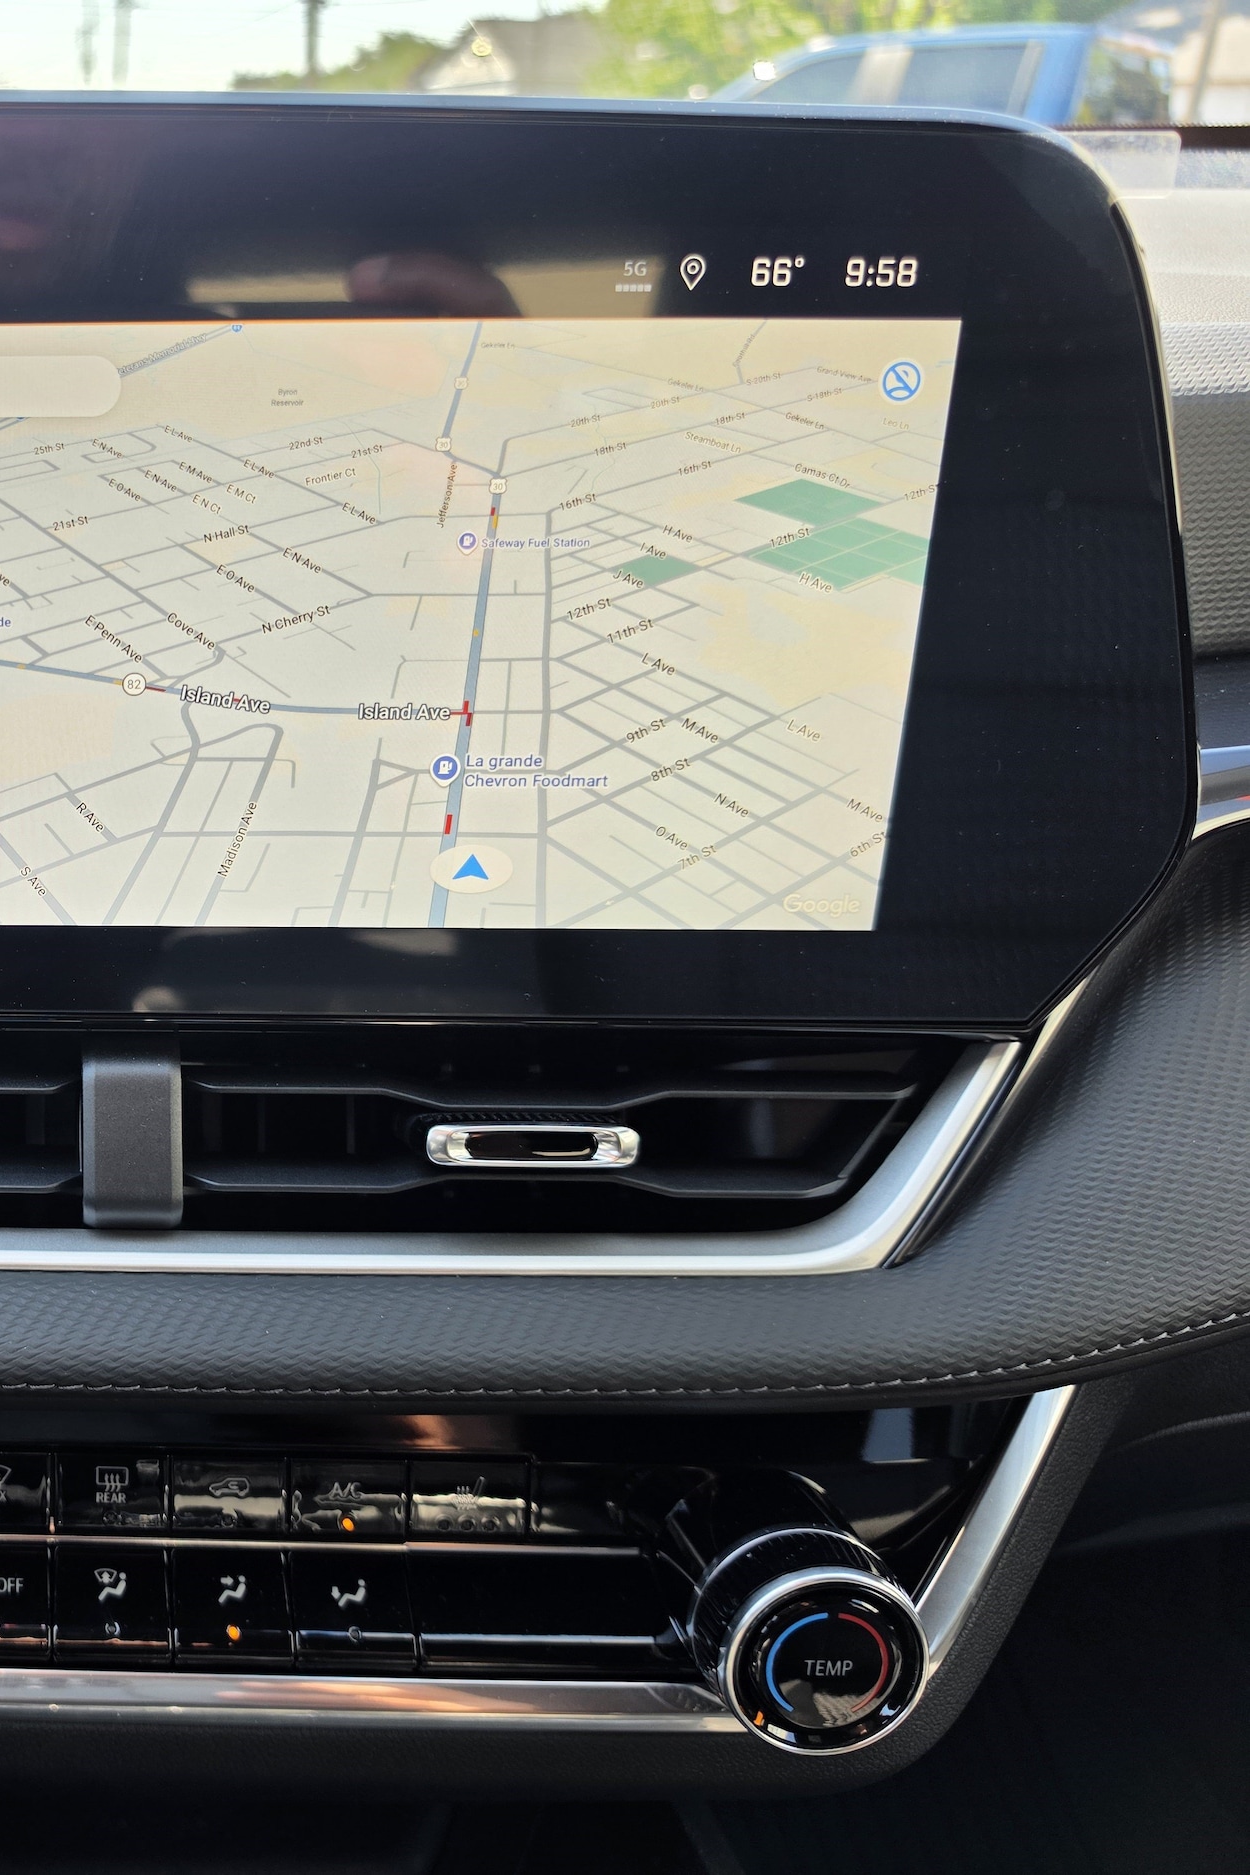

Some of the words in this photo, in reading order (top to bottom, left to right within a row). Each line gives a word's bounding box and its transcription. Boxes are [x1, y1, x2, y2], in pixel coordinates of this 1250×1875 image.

[623, 260, 648, 276] 5G
[751, 256, 804, 287] 66°
[845, 256, 918, 287] 9:58
[117, 357, 150, 376] eterans
[278, 388, 297, 397] Byron
[570, 418, 589, 428] 20th
[590, 415, 600, 423] St
[785, 411, 813, 426] Gekeler
[34, 446, 53, 455] 25th
[54, 443, 65, 451] St
[289, 440, 310, 450] 22nd
[312, 437, 323, 445] St
[351, 448, 371, 458] 21st
[372, 445, 383, 453] St
[594, 446, 614, 456] 18th
[616, 442, 626, 451] St
[685, 432, 730, 451] Steamboat
[731, 444, 741, 453] Ln
[244, 459, 250, 468] E
[258, 466, 275, 478] Ave
[306, 471, 342, 486] Frontier
[345, 468, 356, 477] Ct
[678, 463, 699, 476] 16th
[700, 460, 712, 470] St
[795, 464, 826, 478] Camas
[840, 478, 850, 488] Dr
[227, 485, 234, 493] E
[235, 488, 245, 498] M
[245, 493, 256, 503] Ct
[437, 482, 453, 528] Jefferson
[447, 464, 458, 481] Ave
[558, 498, 583, 510] 16th
[585, 493, 597, 503] St
[904, 488, 926, 501] 12th
[928, 483, 939, 494] S
[342, 503, 349, 512] E
[357, 510, 376, 524] Ave
[53, 519, 75, 531] 21st
[77, 516, 88, 525] St
[204, 534, 212, 543] N
[214, 527, 235, 541] Hall
[237, 525, 249, 534] St
[663, 524, 673, 536] H
[675, 529, 693, 543] Ave
[769, 532, 795, 548] 12th
[797, 527, 810, 539] St
[481, 538, 525, 550] Safeway
[528, 538, 549, 547] Fuel
[554, 538, 590, 547] Station
[646, 545, 667, 559] Ave
[282, 548, 291, 558] E
[291, 553, 302, 563] N
[302, 558, 321, 573] Ave
[216, 565, 225, 574] E
[226, 571, 235, 580] O
[235, 576, 255, 592] Ave
[613, 570, 622, 580] J
[623, 574, 644, 589] Ave
[799, 573, 810, 585] H
[811, 578, 832, 593] Ave
[567, 604, 595, 620] 12th
[597, 597, 611, 609] St
[262, 623, 272, 634] N
[275, 611, 314, 630] Cherry
[317, 605, 330, 616] St
[85, 615, 95, 626] E
[94, 620, 122, 647] Penn
[121, 644, 142, 663] Ave
[167, 613, 194, 636] Cove
[193, 632, 215, 650] Ave
[607, 626, 636, 643] 11th
[638, 619, 653, 632] St
[641, 653, 650, 665] L
[651, 658, 676, 676] Ave
[127, 680, 141, 690] 82
[180, 685, 235, 709] Island
[236, 694, 271, 714] Ave
[358, 703, 412, 720] Island
[415, 704, 450, 720] Ave
[626, 726, 650, 743] 9th
[650, 718, 666, 733] St
[681, 718, 697, 733] M
[695, 726, 719, 744] Ave
[786, 719, 795, 732] L
[796, 724, 821, 742] Ave
[466, 755, 483, 767] La
[488, 754, 542, 770] grande
[651, 765, 674, 782] 8th
[675, 757, 691, 772] St
[464, 774, 527, 788] Chevron
[533, 774, 608, 788] Foodmart
[714, 793, 728, 807] N
[726, 800, 749, 818] Ave
[847, 798, 861, 811] M
[860, 806, 883, 822] Ave
[76, 802, 86, 814] R
[84, 812, 104, 832] Ave
[217, 827, 248, 877] Madison
[240, 802, 257, 826] Ave
[656, 827, 666, 837] O
[665, 832, 688, 850] Ave
[677, 853, 700, 870] 7th
[702, 844, 716, 857] St
[850, 841, 871, 857] 6th
[21, 866, 31, 877] S
[27, 876, 47, 897] Ave
[783, 894, 861, 917] Google
[96, 1492, 126, 1503] REAR
[329, 1481, 361, 1500] A/C
[804, 1659, 853, 1676] TEMP
